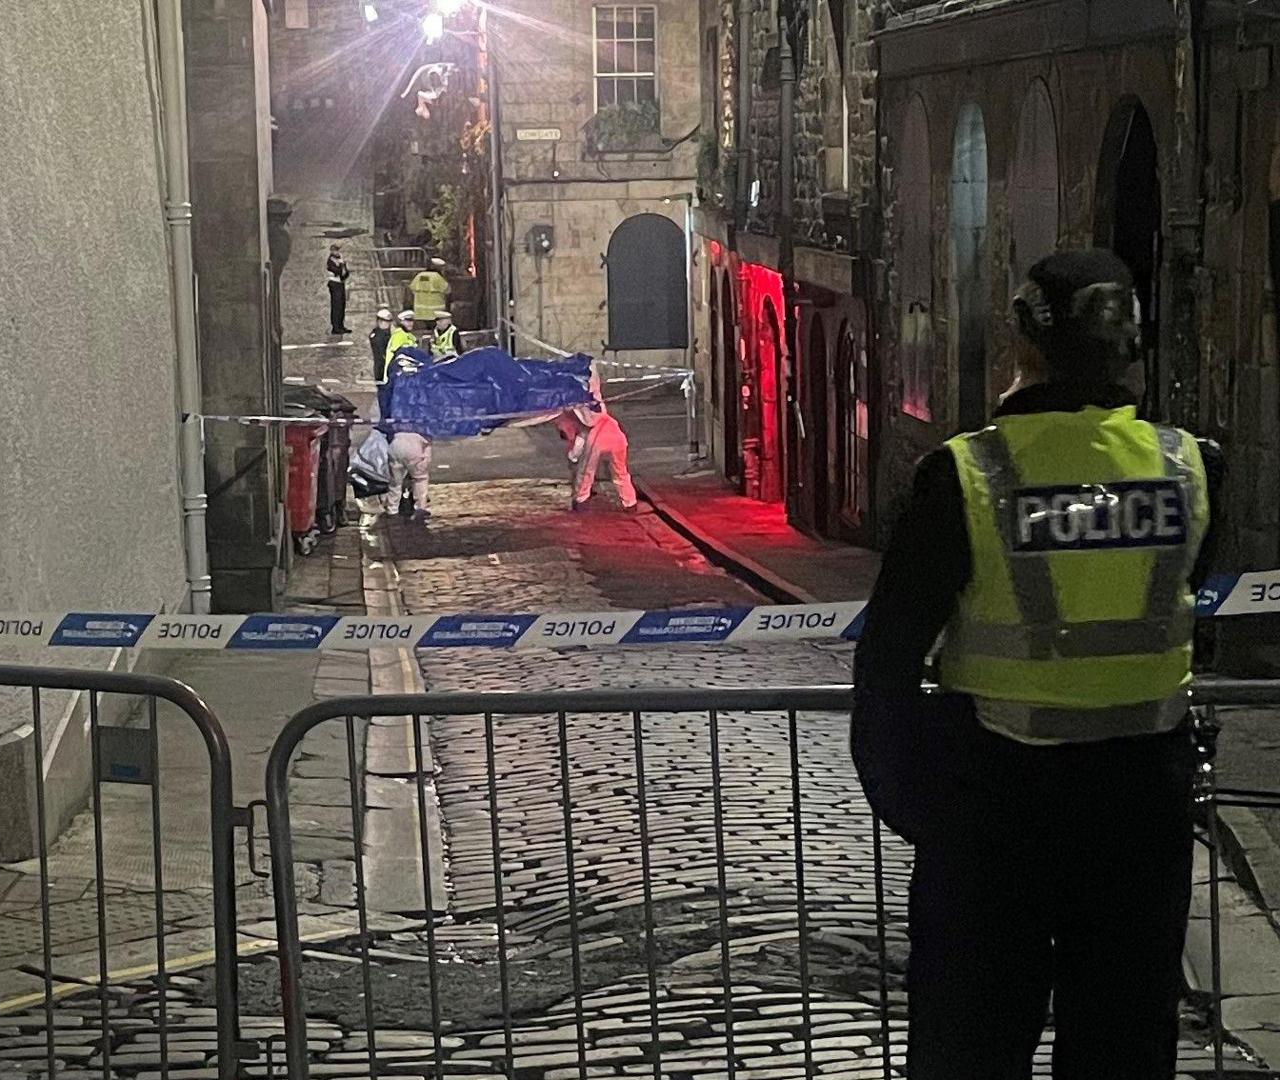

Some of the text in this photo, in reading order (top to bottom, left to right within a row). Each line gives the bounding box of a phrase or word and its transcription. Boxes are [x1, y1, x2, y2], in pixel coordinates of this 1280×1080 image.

[1019, 489, 1183, 544] POLICE
[542, 619, 615, 636] POLICE
[758, 611, 836, 630] POLICE
[157, 622, 223, 639] POLICE
[344, 623, 412, 640] POLICE
